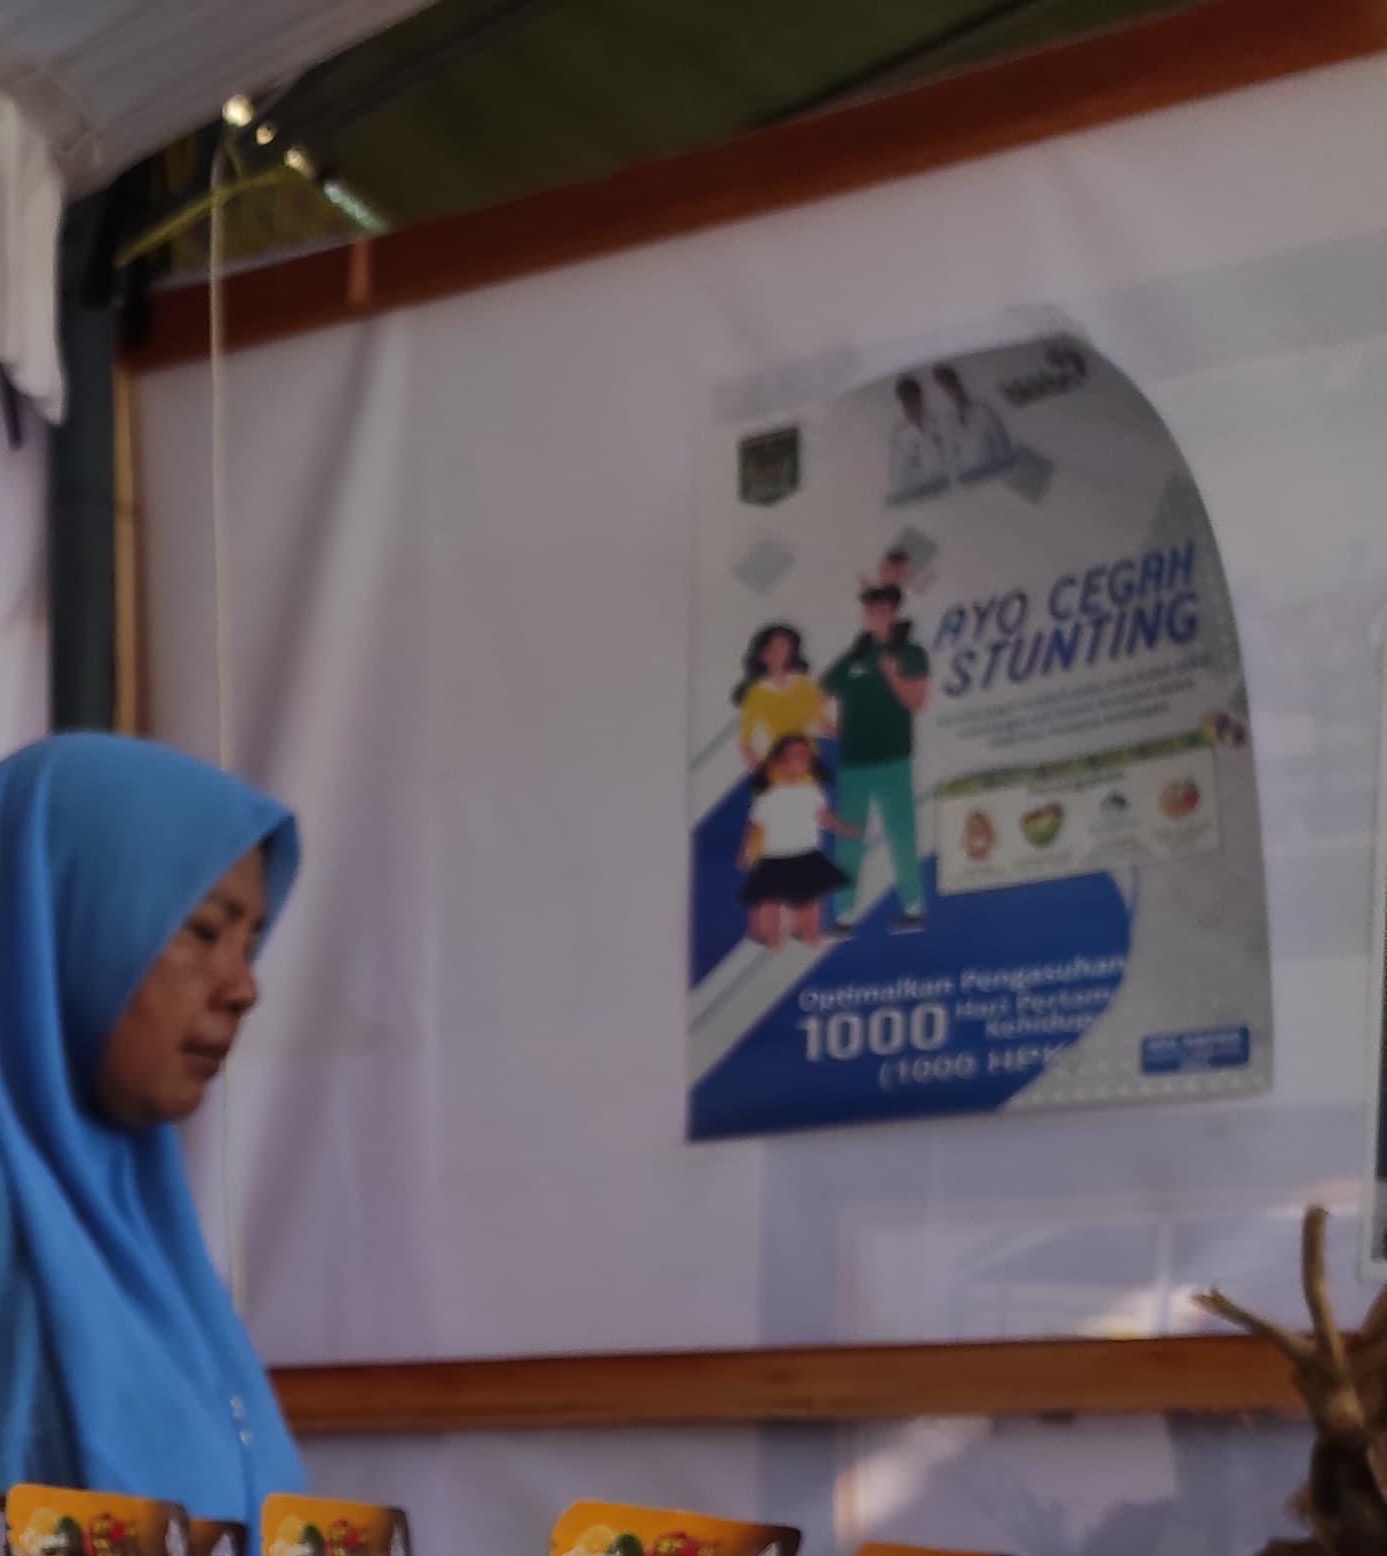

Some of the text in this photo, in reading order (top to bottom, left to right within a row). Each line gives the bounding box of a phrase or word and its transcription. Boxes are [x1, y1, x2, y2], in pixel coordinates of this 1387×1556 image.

[934, 542, 1195, 653] AYO CEGAH
[944, 592, 1199, 698] STUNTING
[798, 1001, 949, 1063] 1000
